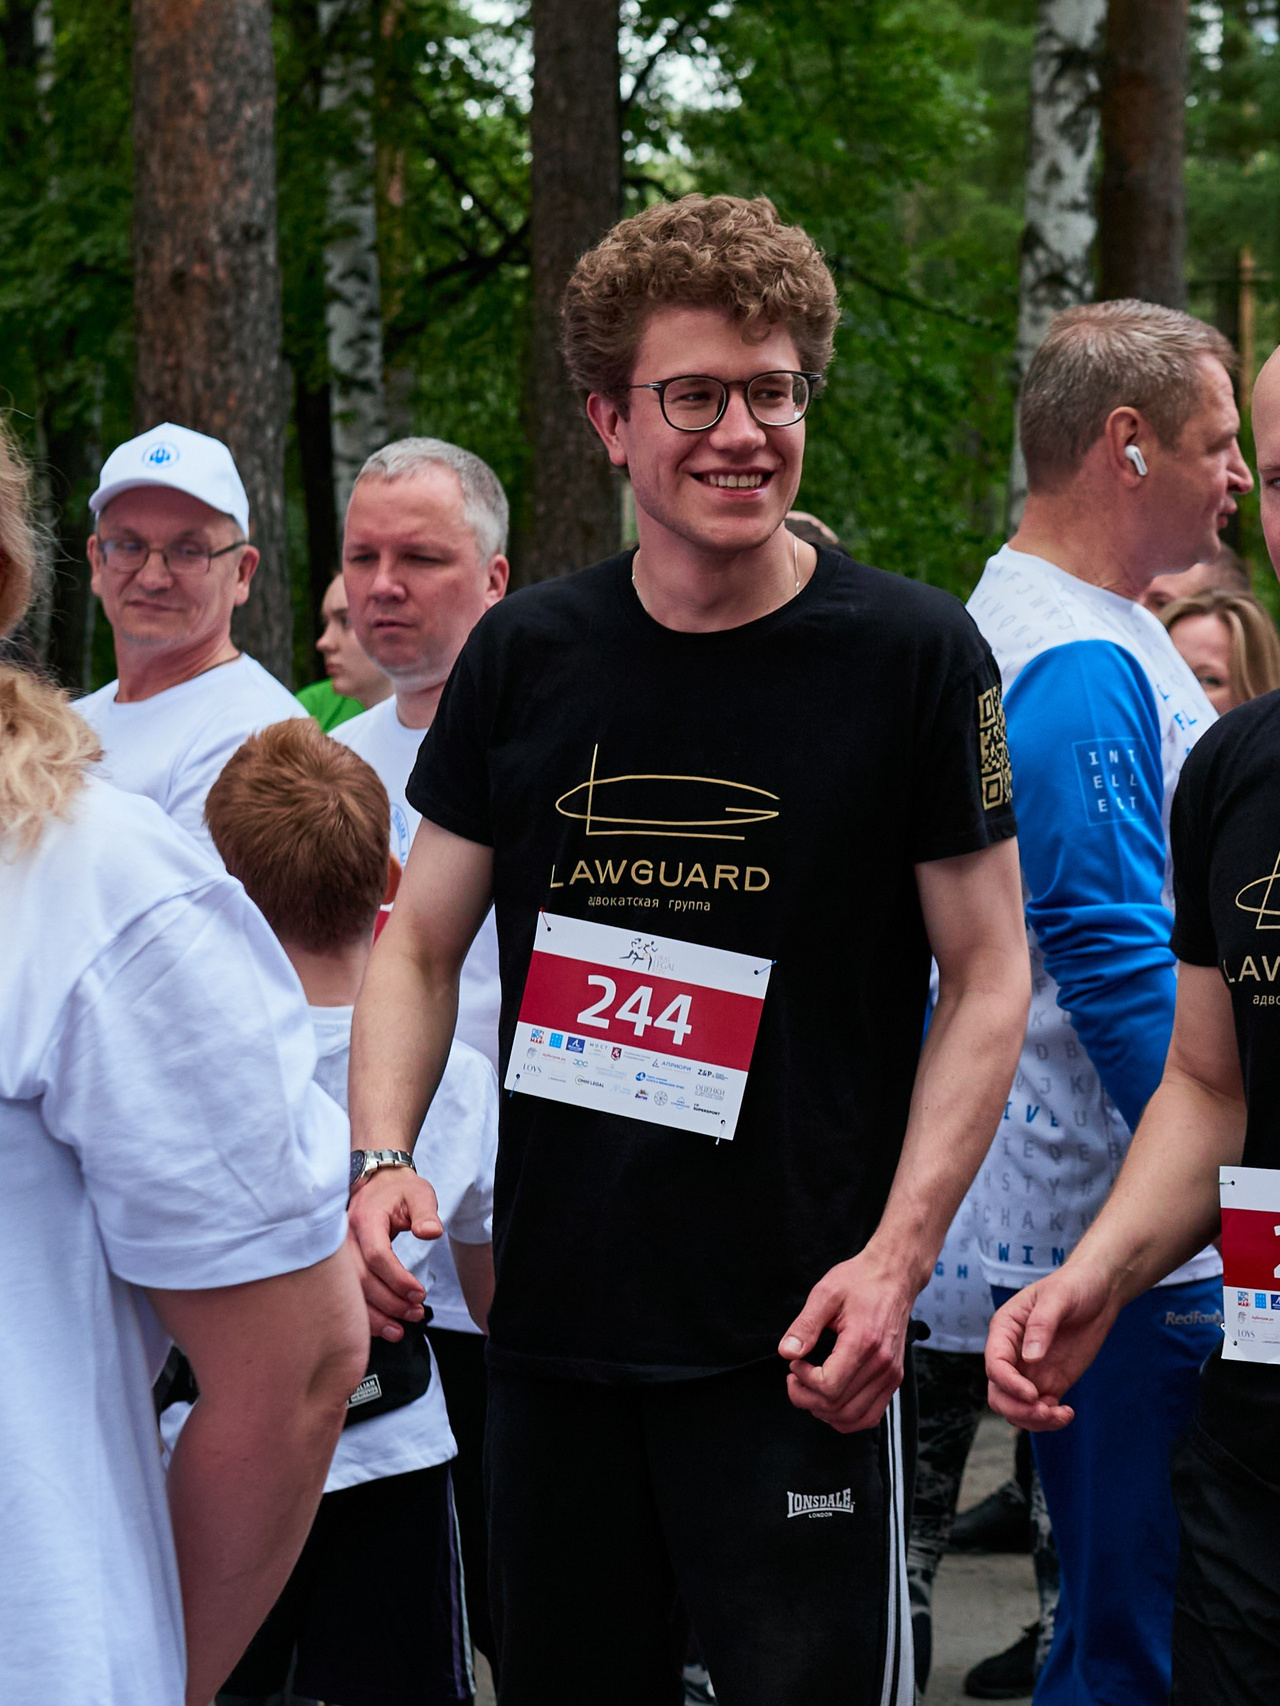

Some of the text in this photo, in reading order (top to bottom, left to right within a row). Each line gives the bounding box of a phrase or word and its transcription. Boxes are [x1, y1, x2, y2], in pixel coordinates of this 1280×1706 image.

[550, 859, 771, 892] LAWGUARD
[669, 899, 711, 912] группа
[576, 974, 692, 1046] 244
[662, 1060, 692, 1072] АПРИОРИ
[786, 1487, 855, 1519] LONSDALE
